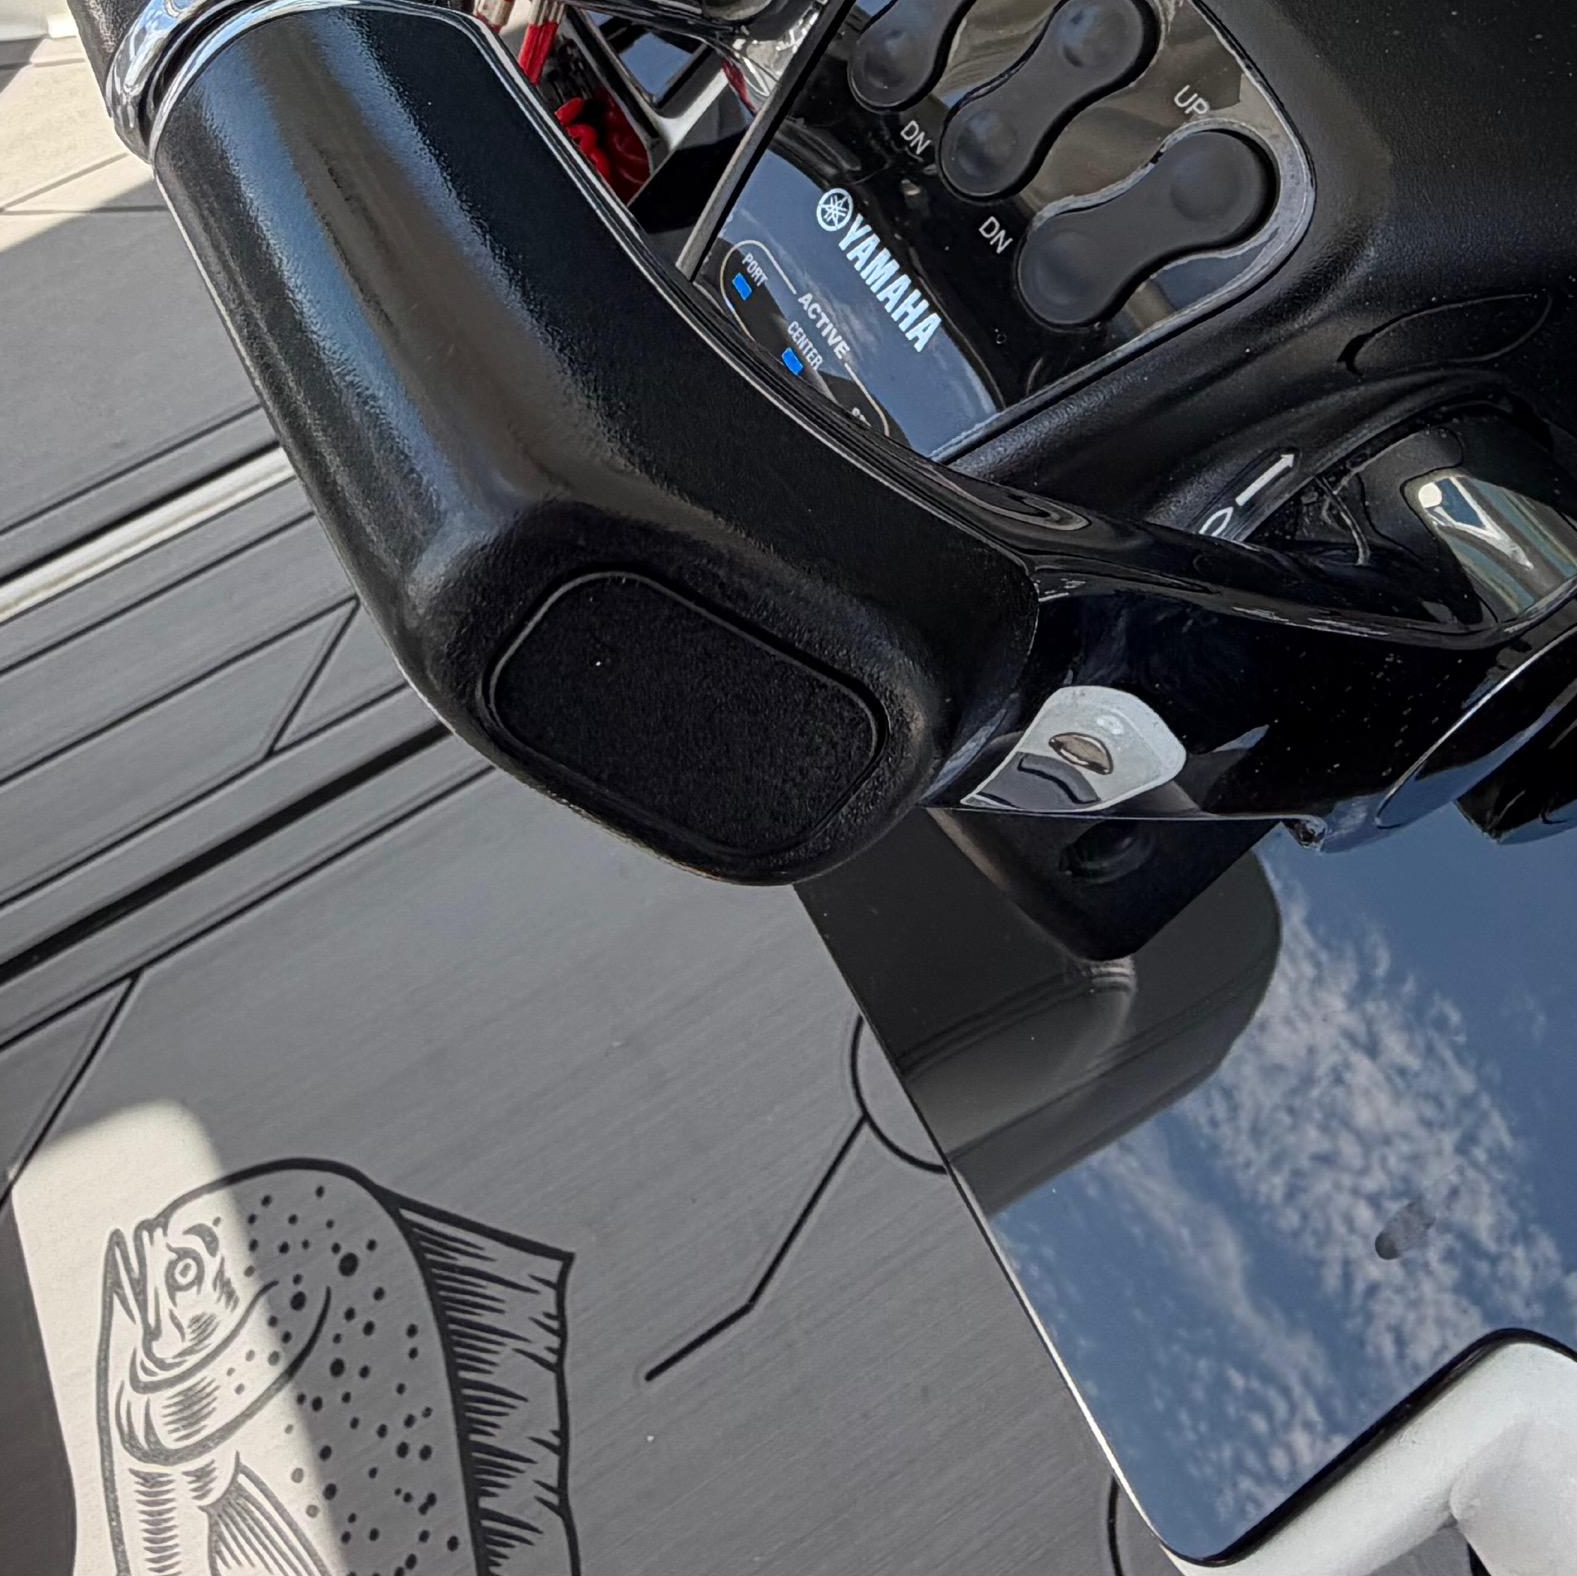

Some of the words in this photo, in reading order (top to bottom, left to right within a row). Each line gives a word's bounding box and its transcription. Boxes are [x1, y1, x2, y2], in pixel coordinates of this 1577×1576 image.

[1173, 85, 1211, 120] UP
[899, 118, 933, 156] DN
[977, 215, 1014, 254] DN
[741, 252, 769, 287] PORT
[836, 211, 944, 353] YAMAHA
[787, 320, 824, 371] CENTER
[798, 292, 851, 360] ACTIVE
